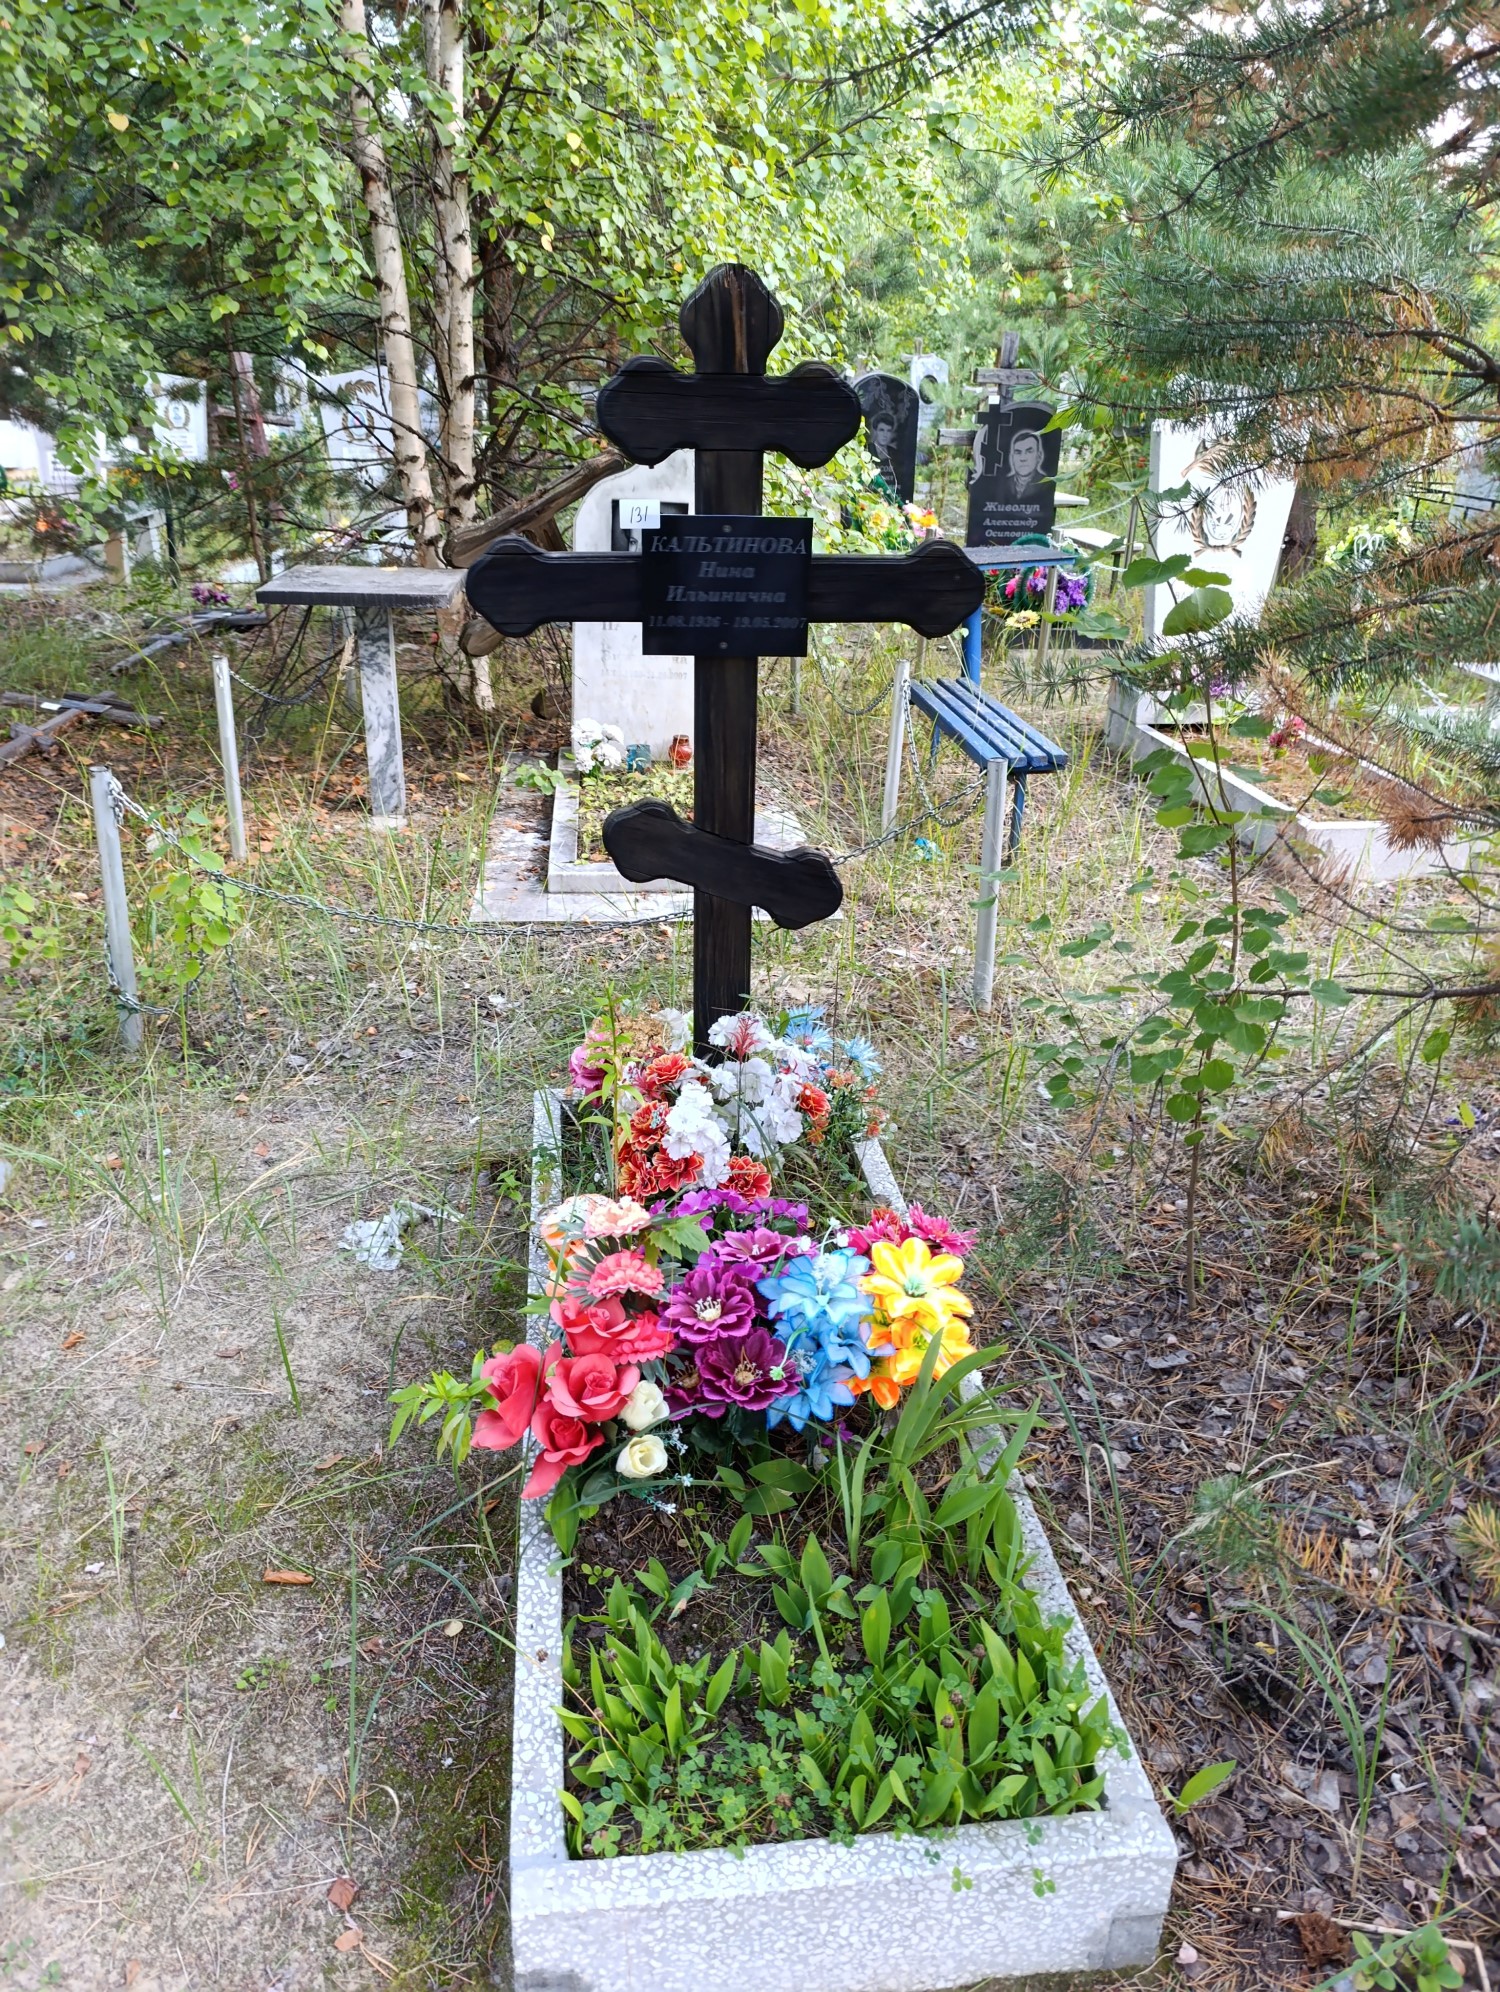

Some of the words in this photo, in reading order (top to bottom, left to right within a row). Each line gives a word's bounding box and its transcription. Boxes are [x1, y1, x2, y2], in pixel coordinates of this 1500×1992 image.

[630, 506, 648, 524] 131
[983, 502, 1041, 515] Живолуп
[983, 517, 1038, 528] Александр
[650, 535, 807, 555] КАЛЬТИНОВА
[698, 561, 756, 578] Нина
[666, 585, 787, 603] Ильинична
